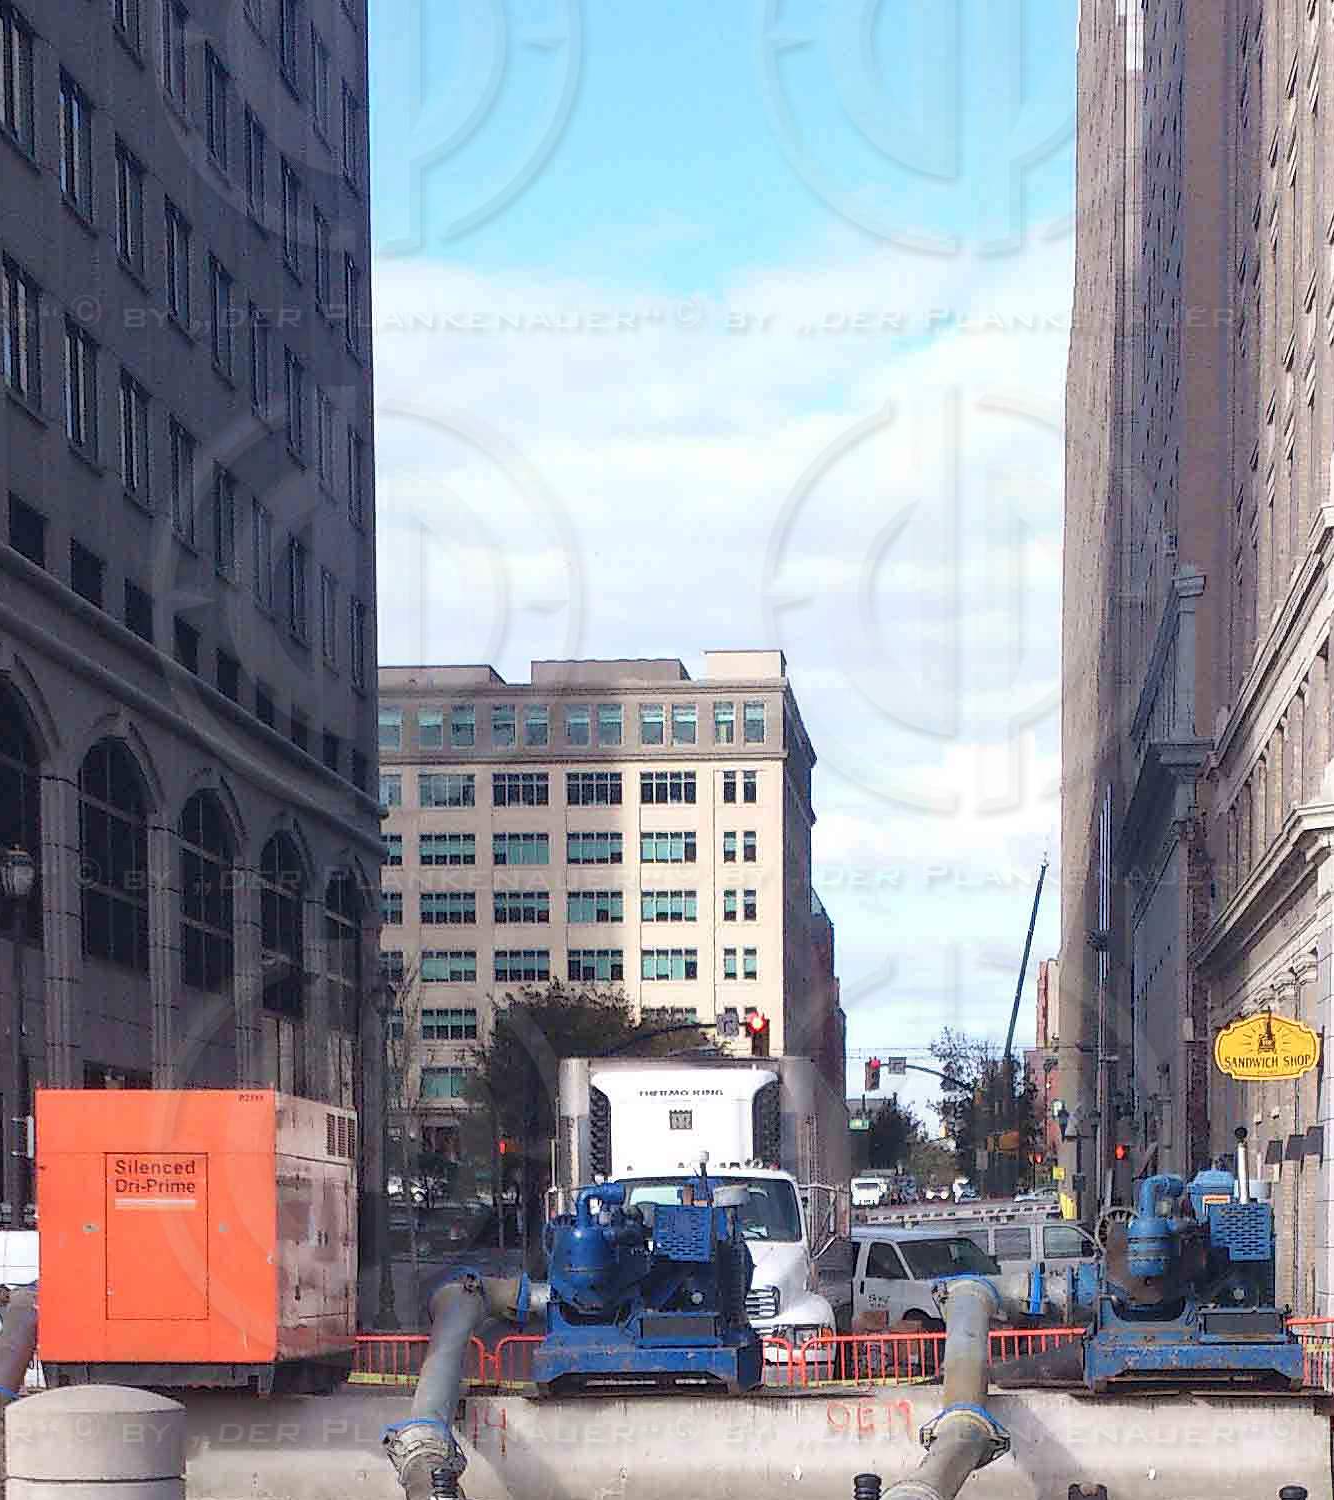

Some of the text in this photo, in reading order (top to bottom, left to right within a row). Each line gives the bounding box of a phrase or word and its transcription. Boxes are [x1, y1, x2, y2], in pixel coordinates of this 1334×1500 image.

[1225, 1054, 1311, 1069] SANDWICH SHOP
[114, 1159, 196, 1175] Silenced
[115, 1179, 196, 1193] Dri-Prime
